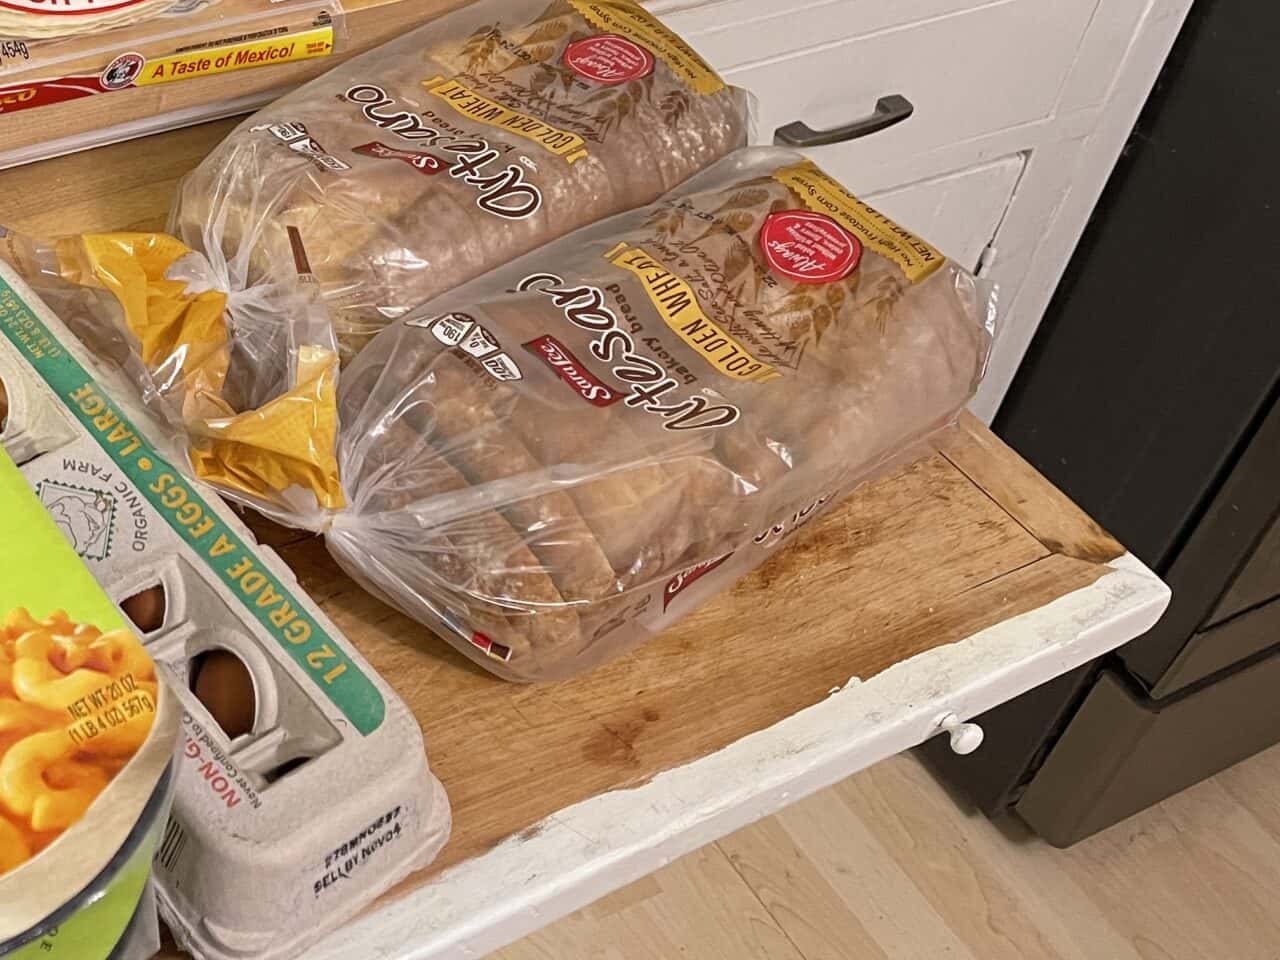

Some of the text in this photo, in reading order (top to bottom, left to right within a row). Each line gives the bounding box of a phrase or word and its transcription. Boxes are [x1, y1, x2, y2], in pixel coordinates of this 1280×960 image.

[2, 40, 30, 60] 454g
[152, 65, 164, 79] A
[171, 59, 211, 76] Taste
[215, 54, 231, 69] of
[234, 42, 296, 65] Mexico!
[573, 55, 626, 77] Always
[449, 86, 572, 149] GOLDEN WHEAT
[791, 176, 816, 196] Syrup
[817, 195, 839, 213] Corn
[840, 211, 876, 241] Fructose
[768, 240, 826, 271] Always
[878, 239, 901, 253] High
[901, 253, 913, 267] No
[909, 242, 935, 262] NET
[606, 283, 697, 385] bakery bread
[682, 319, 763, 378] GOLDEN
[541, 343, 610, 400] Sara Lee
[62, 458, 148, 552] ORGANIC FARM
[68, 383, 349, 685] 12 GRADE A EGGS LARGE
[67, 673, 138, 721] NET WT 20 OZ
[68, 693, 155, 745] (1 LB 4 OZ) 567g
[192, 724, 262, 808] Never Confined to
